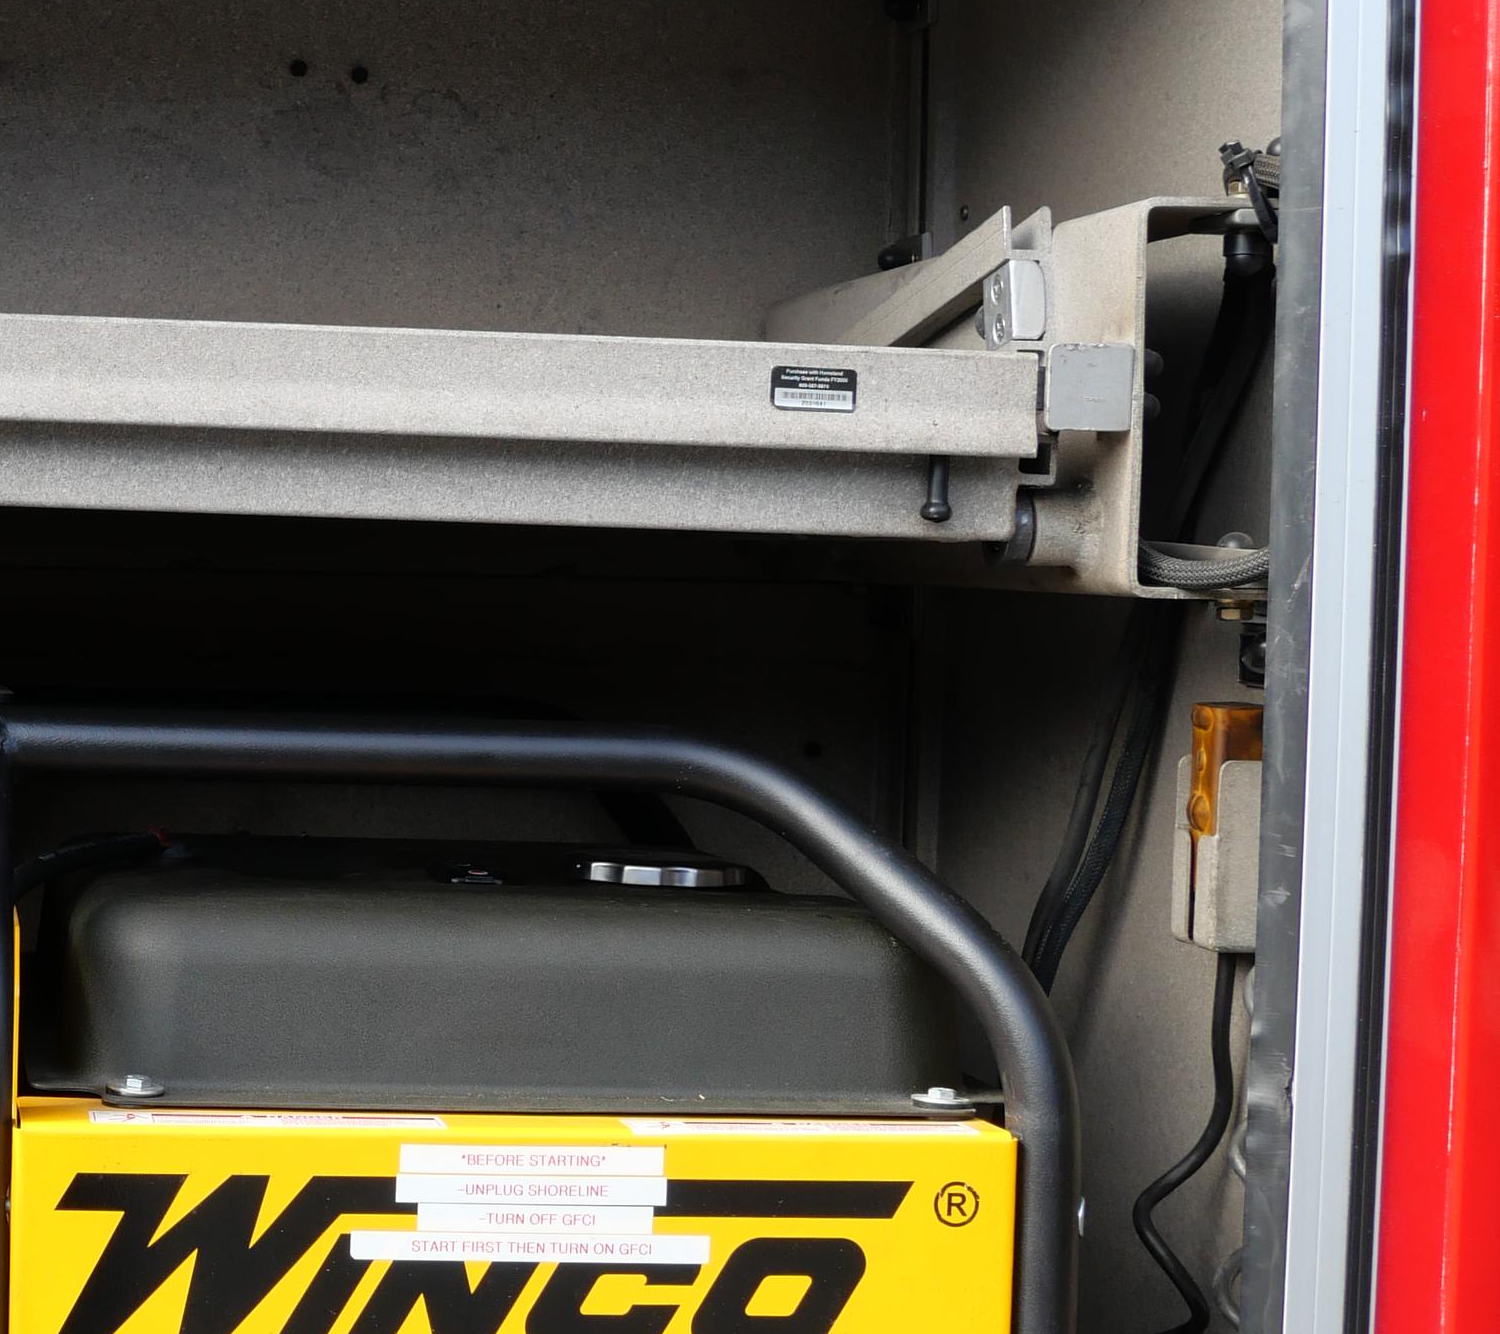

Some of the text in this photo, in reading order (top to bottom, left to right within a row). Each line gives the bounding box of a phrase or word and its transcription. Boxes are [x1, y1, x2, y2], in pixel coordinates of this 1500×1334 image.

[528, 1184, 609, 1197] SHORELINE
[530, 1213, 559, 1226] OFF
[562, 1214, 596, 1227] GFCI
[411, 1240, 652, 1256] START FIRST THEN TURN ON GFCI
